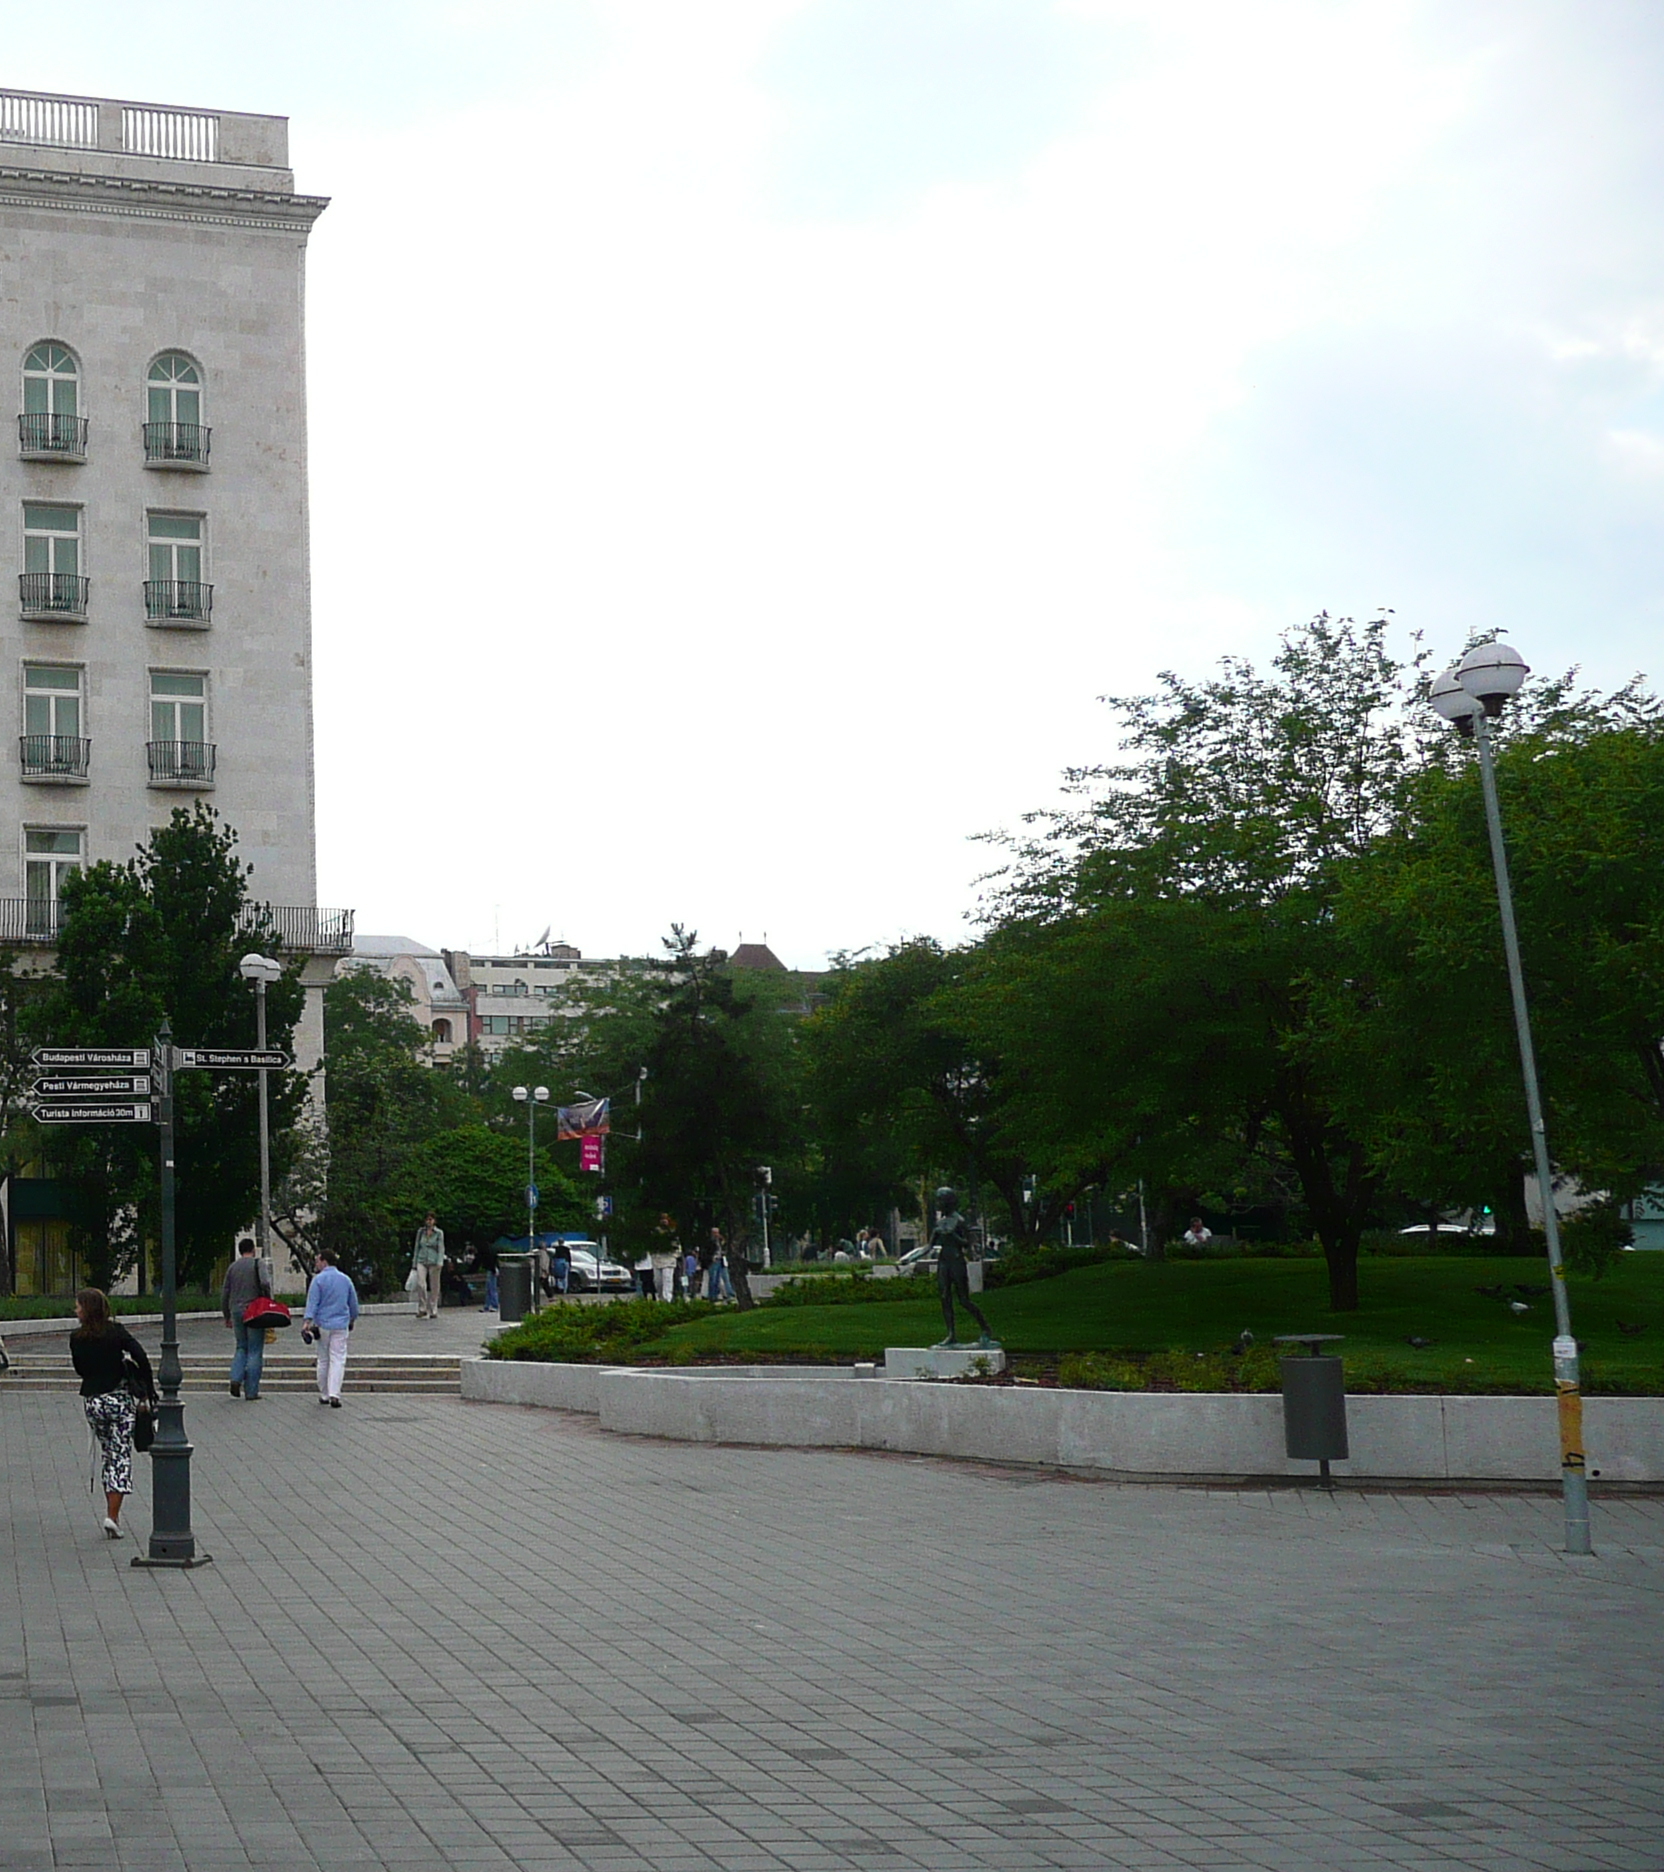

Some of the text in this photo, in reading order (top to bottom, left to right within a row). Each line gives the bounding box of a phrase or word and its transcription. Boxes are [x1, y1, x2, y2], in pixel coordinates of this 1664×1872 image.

[42, 1052, 131, 1063] Budapesti Városháza
[250, 1055, 282, 1064] Basilica
[42, 1080, 130, 1091] Pesti Vármegyeháza
[41, 1108, 70, 1118] Turista
[71, 1108, 115, 1118] Információ
